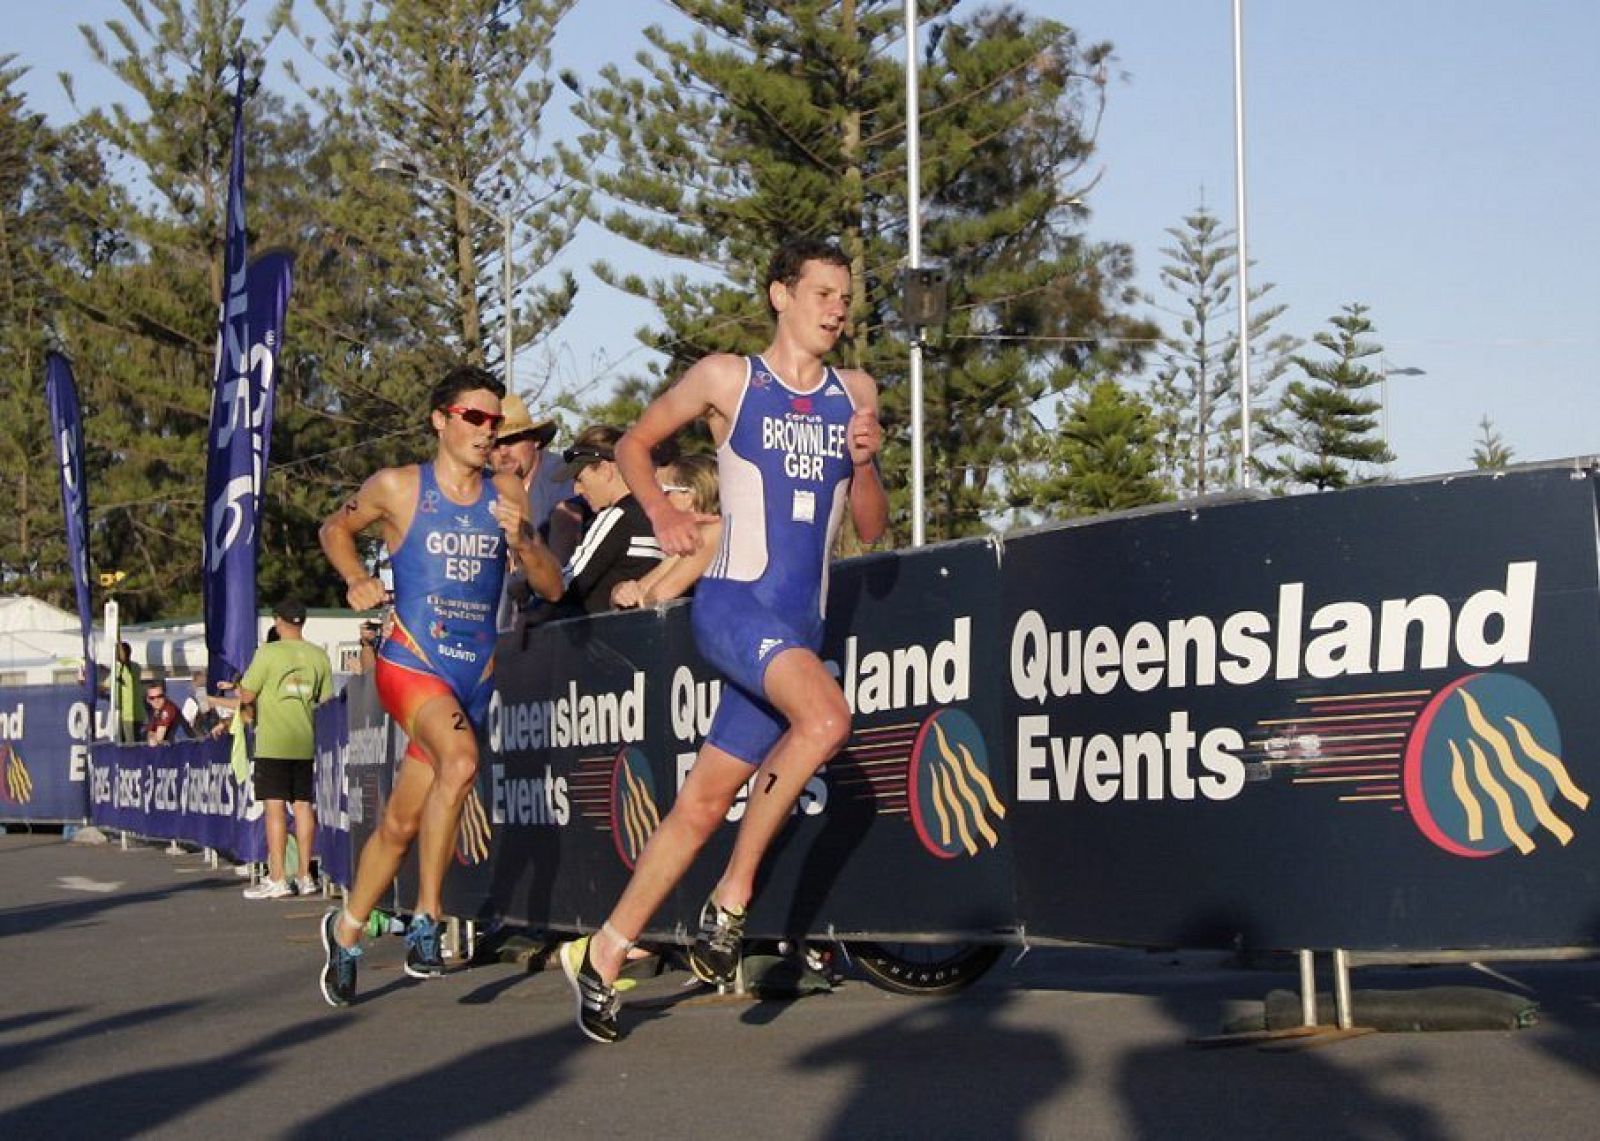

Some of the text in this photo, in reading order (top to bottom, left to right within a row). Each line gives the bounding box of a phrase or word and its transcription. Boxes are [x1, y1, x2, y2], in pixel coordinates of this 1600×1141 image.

[762, 416, 845, 459] BROWNLEE
[785, 453, 824, 481] GBR
[426, 531, 500, 559] GOMEZ
[446, 557, 482, 582] ESP
[1010, 561, 1537, 704] Queensland
[452, 711, 467, 730] 2
[489, 671, 646, 753] Queensland
[1016, 711, 1246, 803] Events
[492, 764, 570, 826] Events
